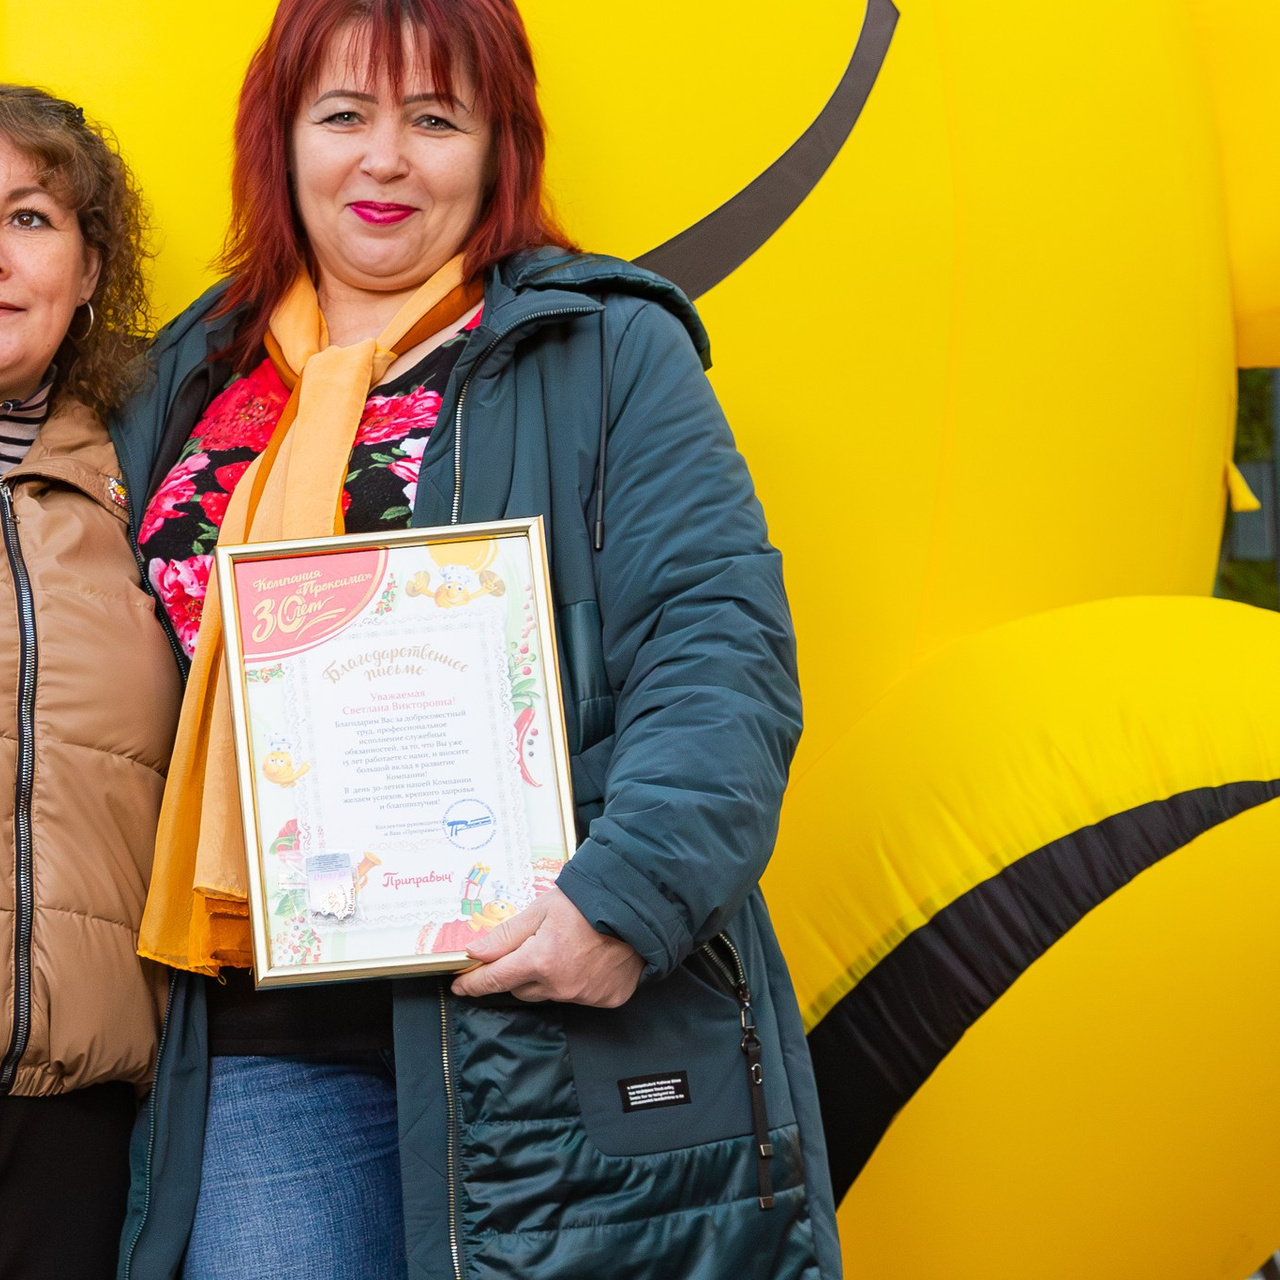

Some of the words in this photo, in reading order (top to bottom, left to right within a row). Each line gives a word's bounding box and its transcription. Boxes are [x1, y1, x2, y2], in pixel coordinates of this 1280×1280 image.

[252, 569, 322, 592] Компания
[295, 572, 372, 598] «Проксима»
[251, 594, 306, 642] 30
[321, 642, 469, 683] Благодарственное
[363, 663, 426, 681] письмо
[342, 705, 390, 716] Светлана
[391, 696, 456, 711] Викторовна!
[370, 690, 426, 702] Уважаемая
[334, 719, 380, 728] Благодарим
[380, 716, 394, 724] Вас
[343, 787, 350, 795] В
[432, 777, 472, 786] Компании
[382, 870, 453, 890] Приправыч
